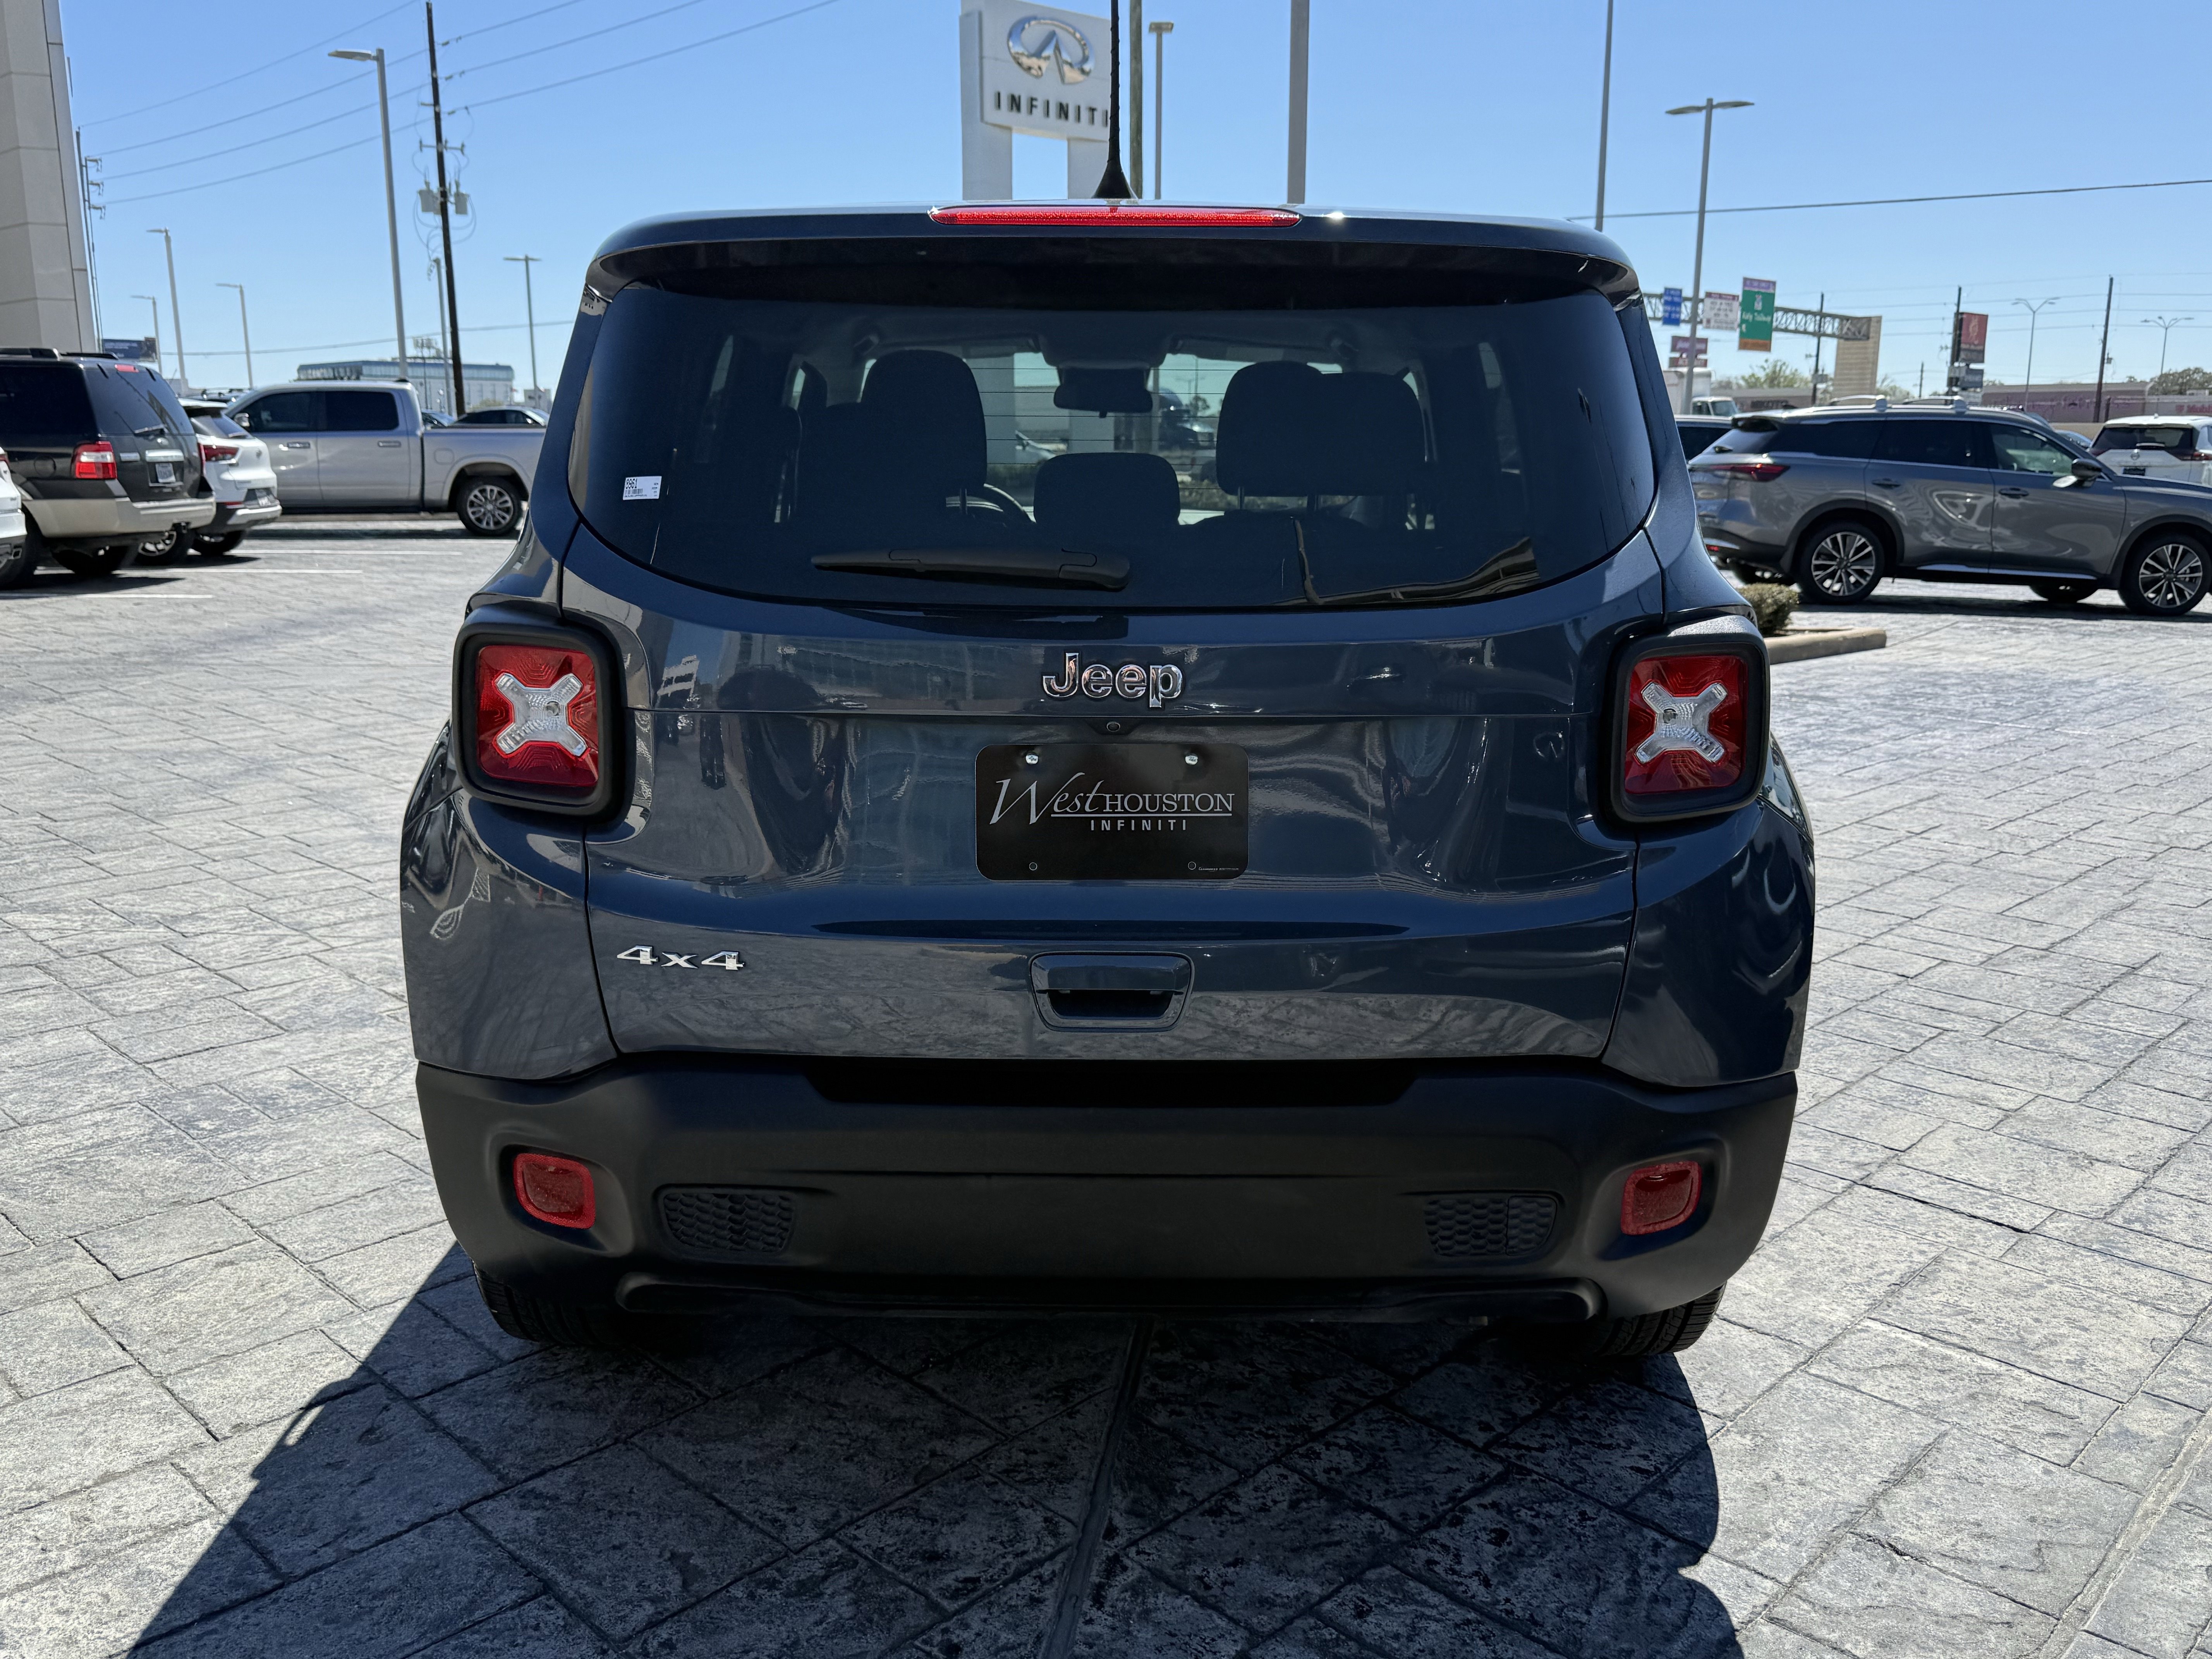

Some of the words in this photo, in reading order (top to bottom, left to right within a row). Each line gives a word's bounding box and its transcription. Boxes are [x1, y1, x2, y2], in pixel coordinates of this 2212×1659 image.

[995, 91, 1108, 127] INFINITI
[1042, 652, 1183, 708] Jeep
[1103, 793, 1235, 812] HOUSTON
[1091, 820, 1187, 831] INFINITI
[617, 945, 745, 970] 4x4
